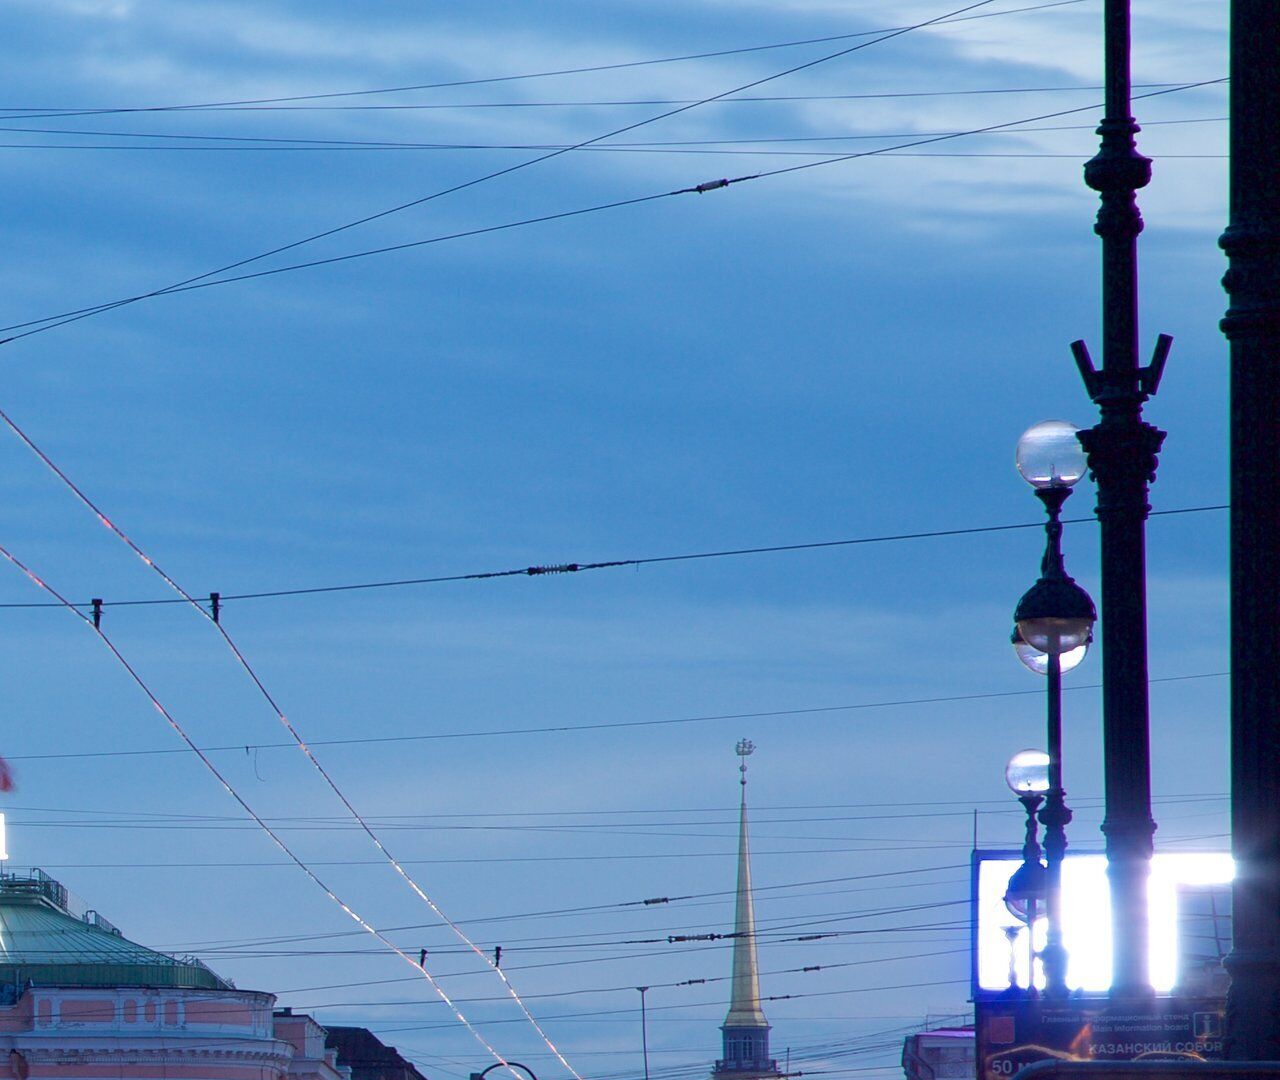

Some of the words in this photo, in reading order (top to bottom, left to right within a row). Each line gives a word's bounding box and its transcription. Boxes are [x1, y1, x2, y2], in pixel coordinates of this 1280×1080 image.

[1088, 1040, 1173, 1056] КАЗАНСКИЙ
[1175, 1041, 1223, 1053] СОБОР
[992, 1060, 1013, 1074] 50
